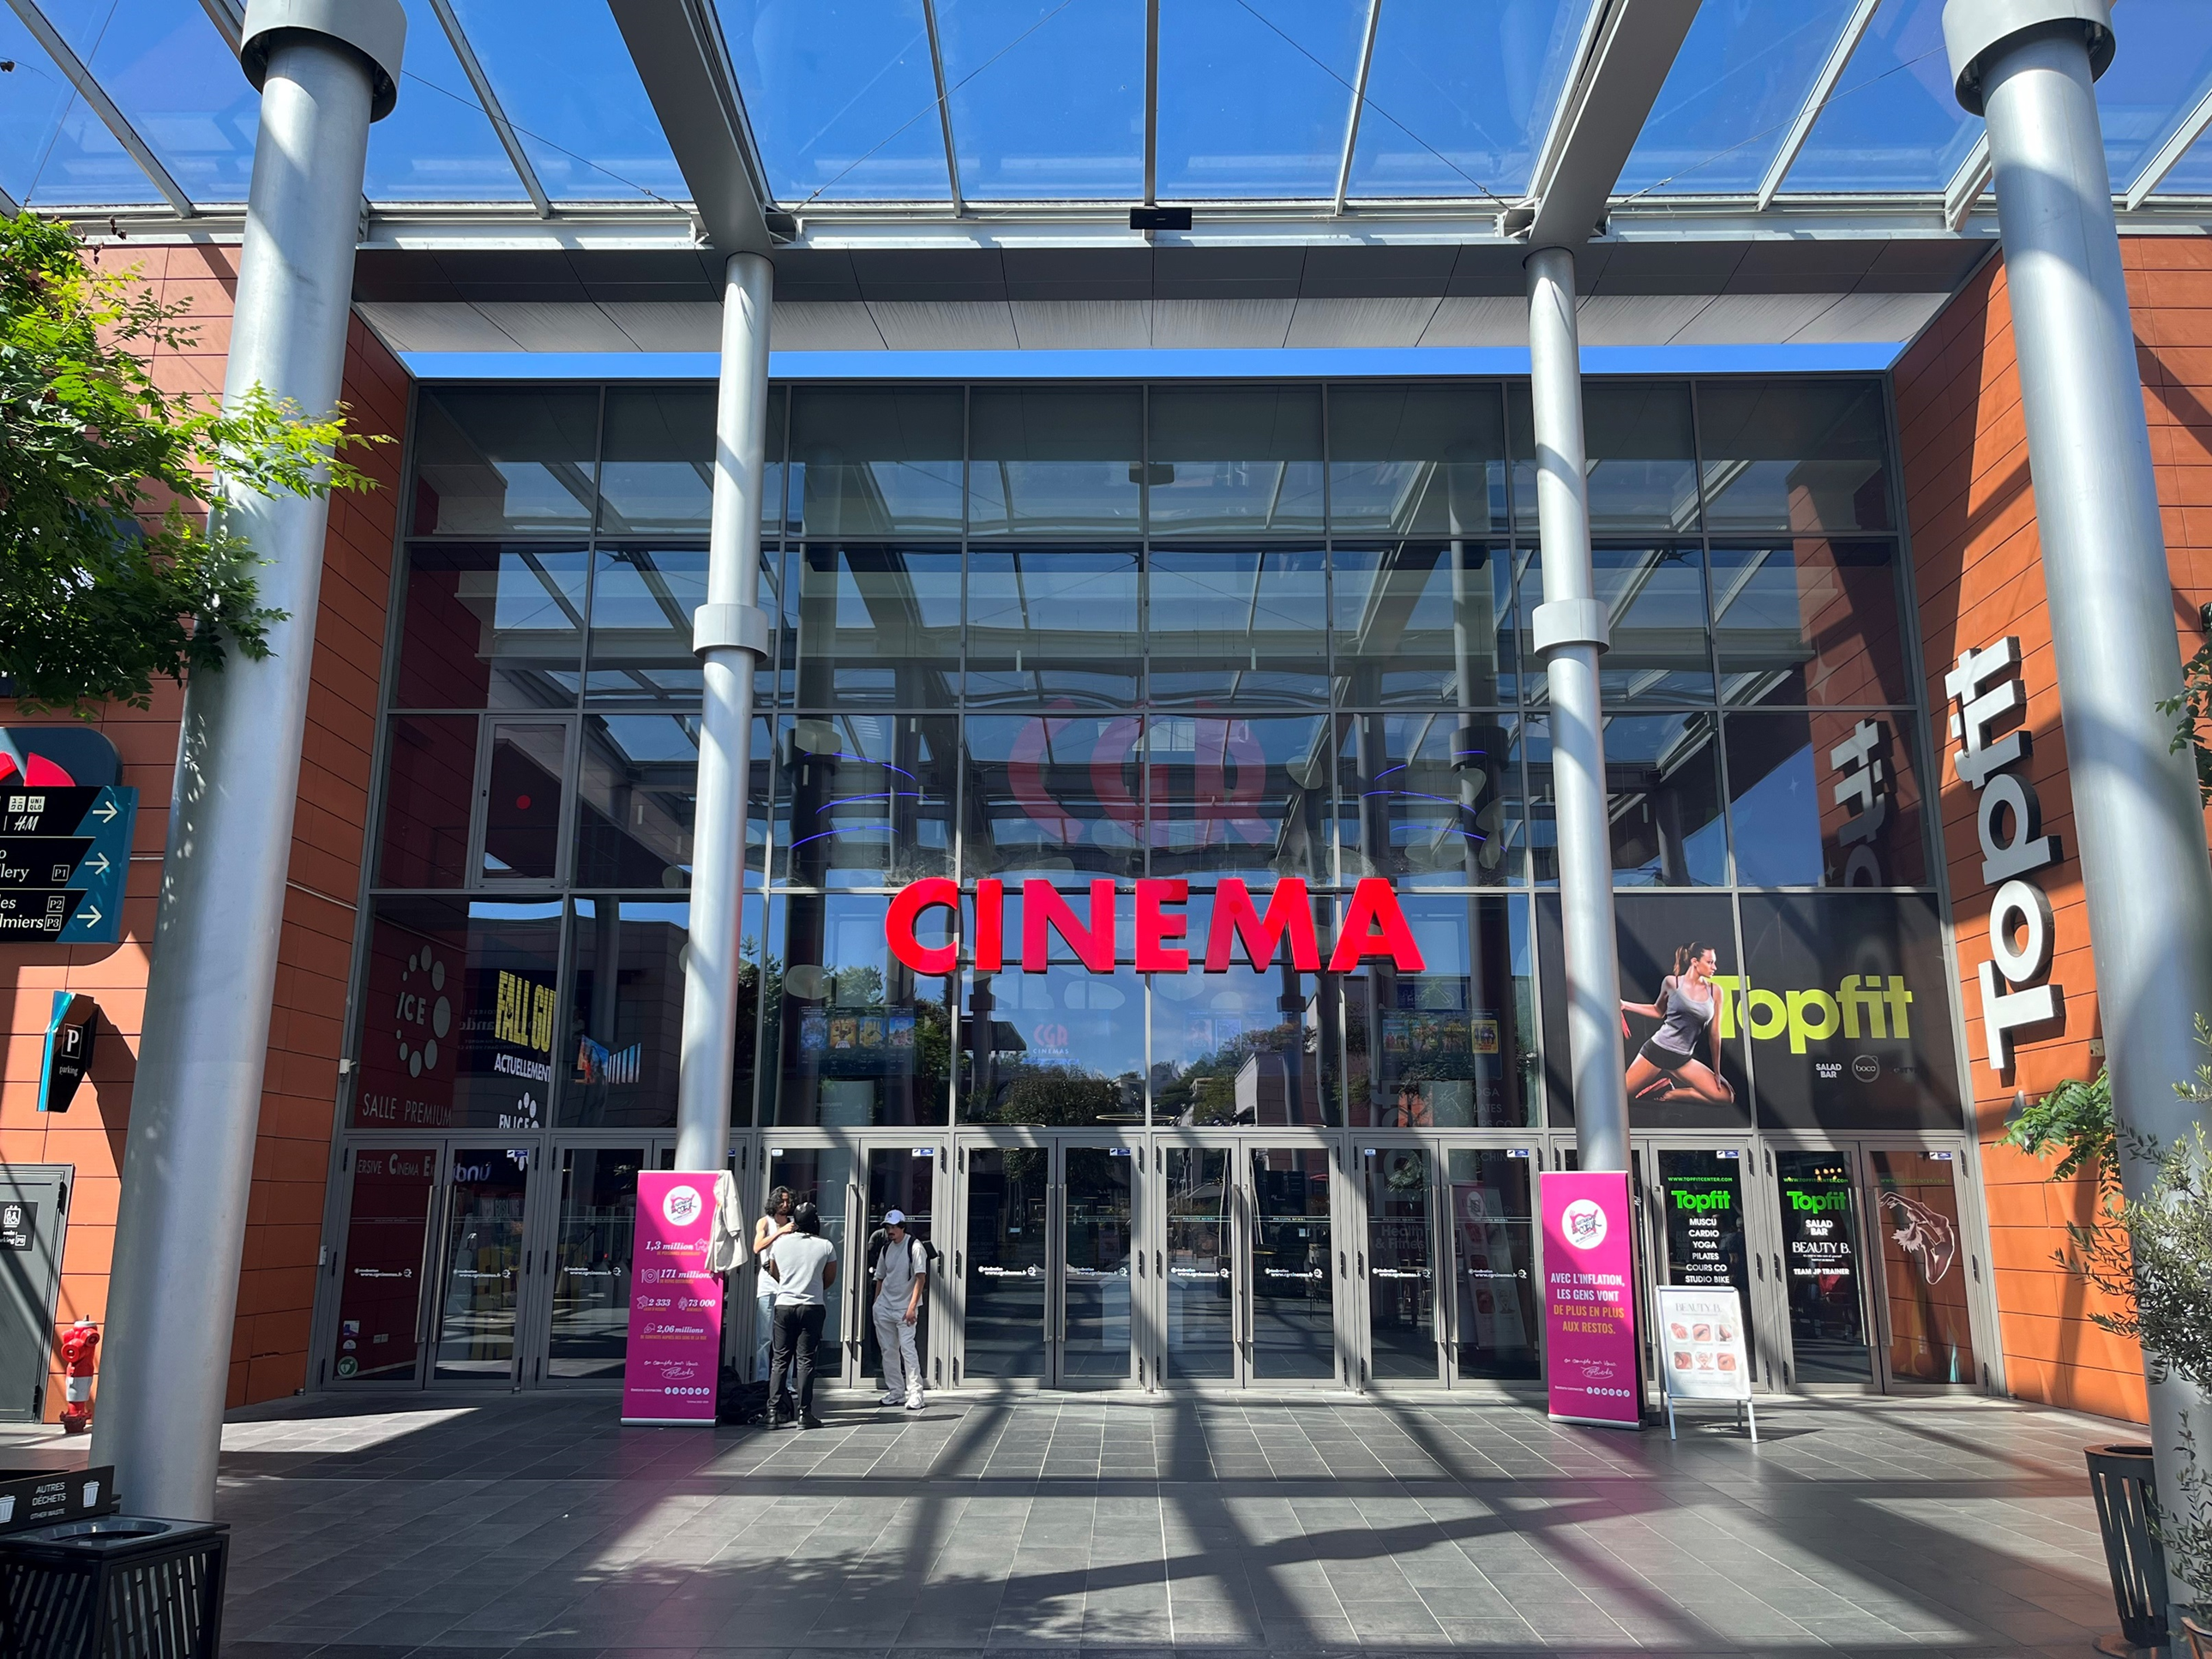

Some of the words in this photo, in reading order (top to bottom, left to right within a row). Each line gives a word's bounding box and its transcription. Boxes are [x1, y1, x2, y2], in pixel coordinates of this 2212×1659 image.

[1007, 699, 1273, 849] CGR
[14, 815, 39, 832] H&M
[1945, 636, 2062, 1072] Topfit
[0, 863, 30, 882] lery
[54, 868, 67, 879] P1
[49, 899, 63, 909] P2
[46, 918, 60, 928] P3
[885, 876, 1427, 975] CINEMA
[396, 991, 426, 1025] ICE
[495, 970, 532, 1047] FALL
[1710, 974, 1913, 1055] Topfit
[66, 1029, 80, 1052] P
[59, 1065, 79, 1077] parking
[363, 1092, 398, 1121] SALLE
[405, 1099, 452, 1127] PREMIUM
[357, 1158, 383, 1175] ERSIVE
[1671, 1190, 1731, 1213] Topfit
[1786, 1190, 1847, 1214] Topfit
[1805, 1219, 1834, 1228] SALAD
[1810, 1227, 1829, 1235] BAR
[646, 1241, 662, 1251] 1,3
[1692, 1241, 1717, 1249] YOGA
[1792, 1241, 1837, 1253] BEAUTY
[1840, 1242, 1852, 1254] B.
[660, 1269, 676, 1278] 171
[1550, 1272, 1571, 1283] AVEC
[1573, 1273, 1626, 1287] L'INFLATION,
[1685, 1275, 1712, 1283] STUDIO
[1557, 1289, 1571, 1300] LES
[1573, 1289, 1595, 1301] GENS
[1596, 1289, 1620, 1302] VONT
[656, 1298, 671, 1307] 333
[1675, 1302, 1711, 1313] BEAUTY
[1553, 1304, 1564, 1315] DE
[1566, 1305, 1587, 1317] PLUS
[1589, 1306, 1600, 1317] EN
[1602, 1307, 1625, 1319] PLUS
[657, 1325, 675, 1334] 2,06
[1562, 1320, 1580, 1332] AUX
[1581, 1322, 1616, 1335] RESTOS.
[35, 1482, 66, 1494] AUTRES
[32, 1492, 66, 1506] DÉCHETS
[30, 1512, 46, 1520] OTHER
[48, 1508, 65, 1518] WASTE
